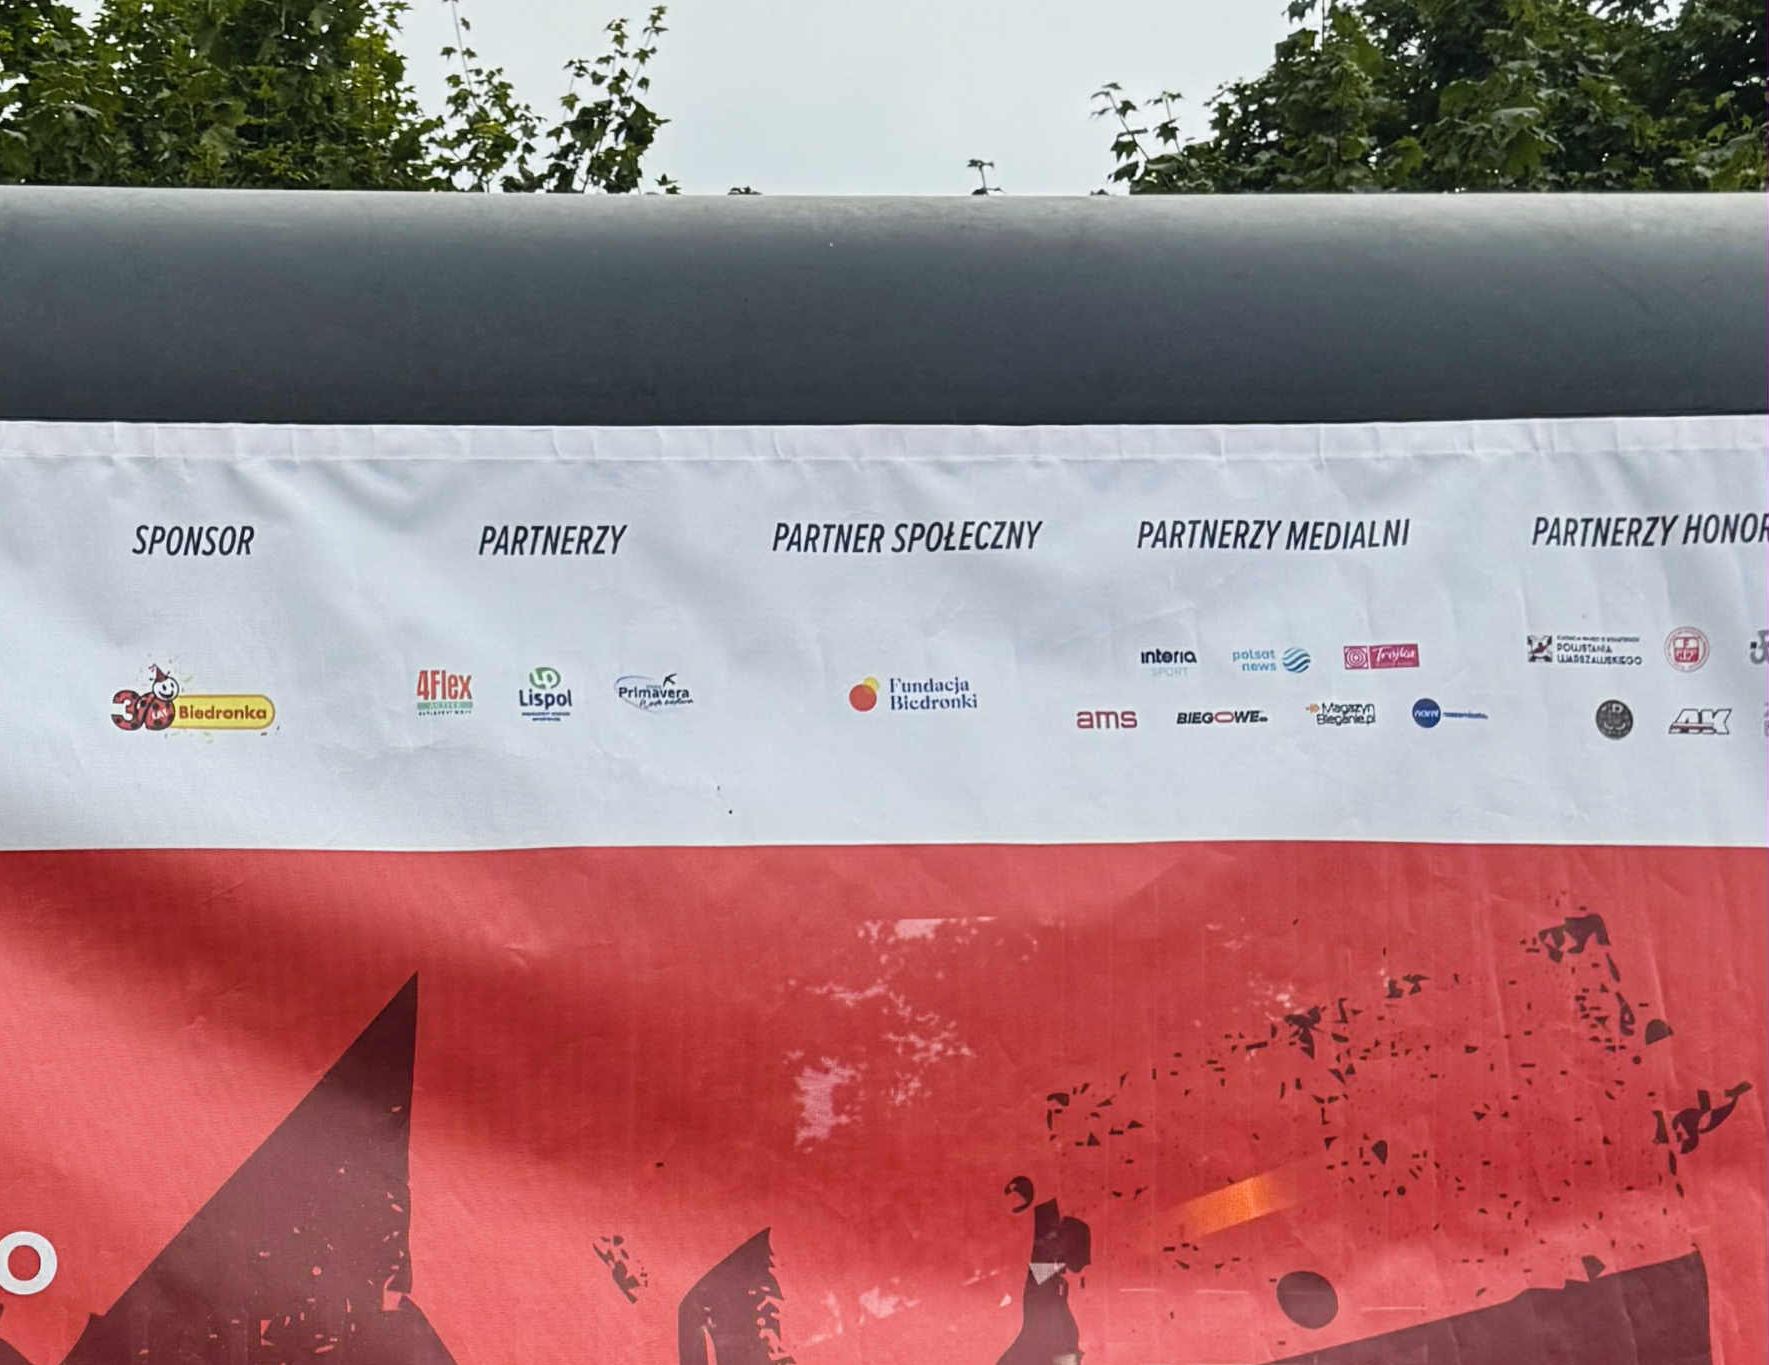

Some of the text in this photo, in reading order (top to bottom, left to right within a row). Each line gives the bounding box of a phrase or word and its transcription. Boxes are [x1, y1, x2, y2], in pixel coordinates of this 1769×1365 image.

[772, 521, 1043, 552] PARTNER SPOŁECZNY
[1137, 518, 1411, 550] PARTNERZY MEDIALNI
[1532, 515, 1678, 547] PARTNERZY
[132, 525, 254, 556] SPONSOR
[478, 525, 627, 555] PARTNERZY
[1141, 648, 1197, 664] interia
[1232, 649, 1275, 661] polsat
[1242, 662, 1276, 671] news
[416, 670, 472, 700] 4Flex
[618, 686, 690, 699] Primavera
[890, 677, 969, 694] Fundacja
[519, 689, 572, 710] Lispol
[891, 694, 977, 710] Biedronki
[179, 705, 267, 720] Biedronka
[1322, 703, 1375, 716] Magazyn
[1077, 711, 1137, 729] ams
